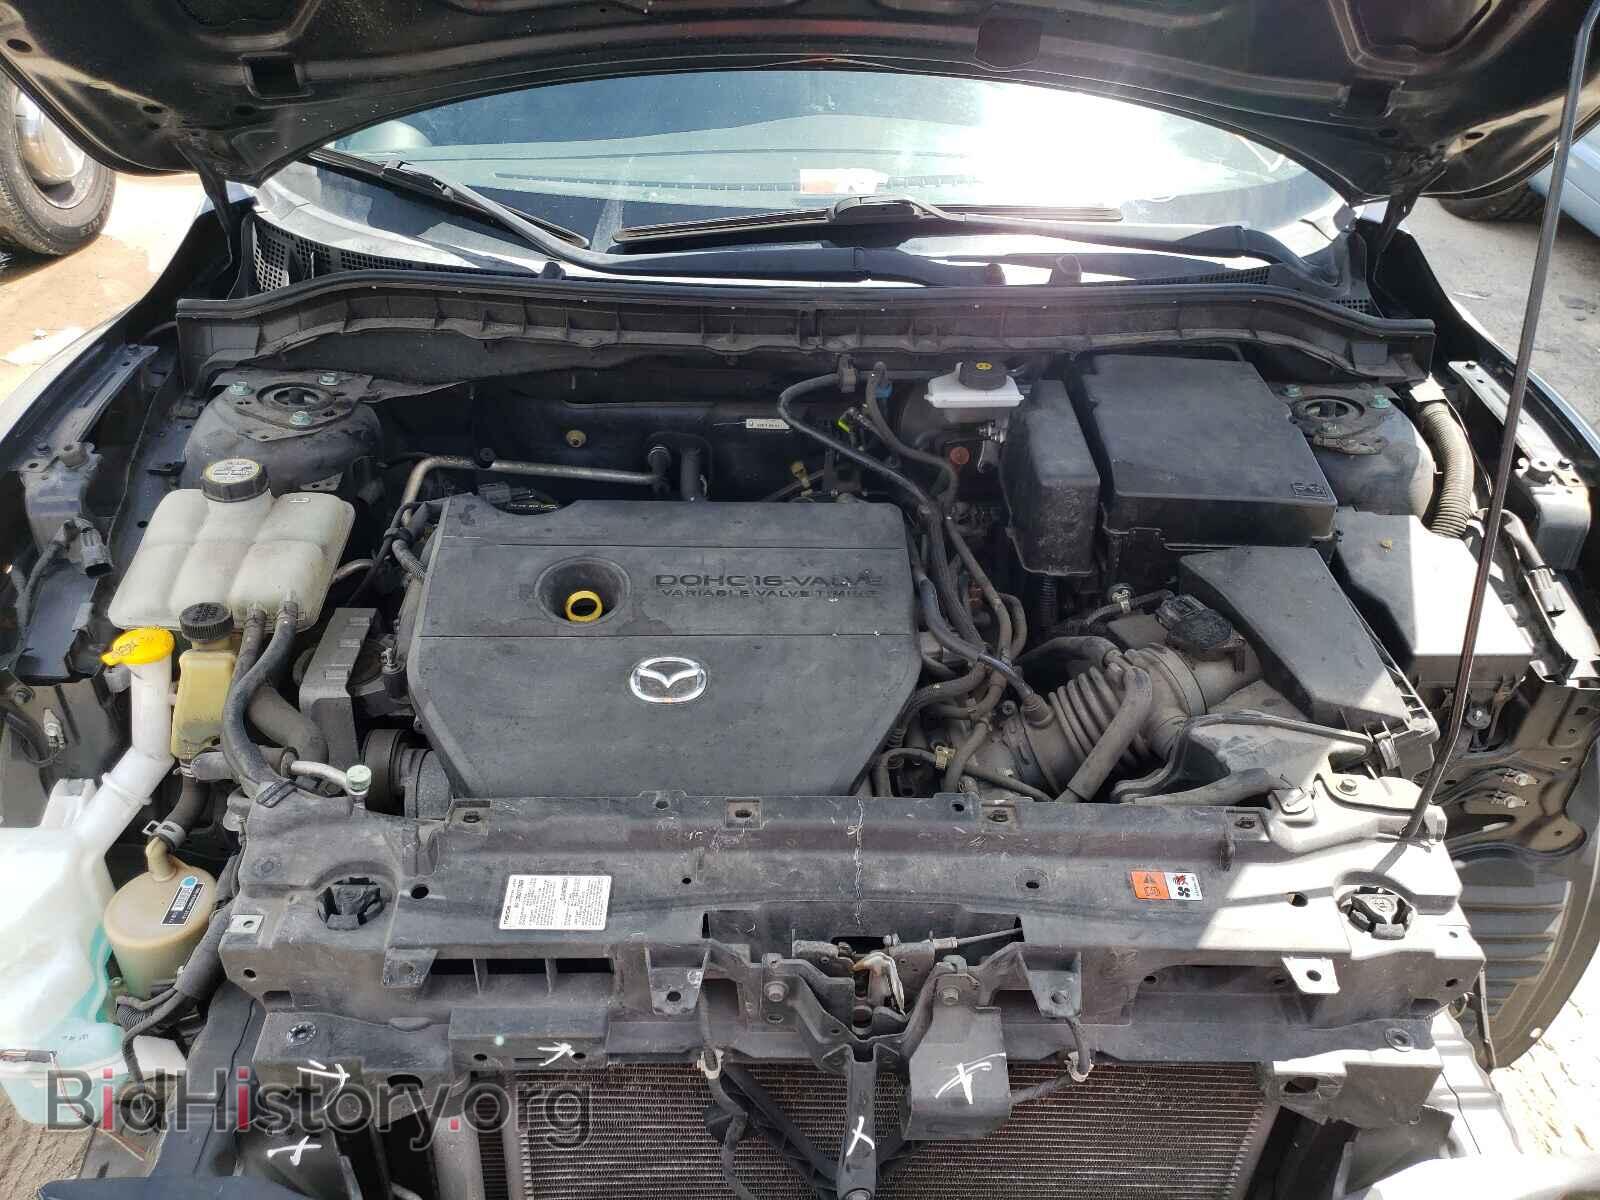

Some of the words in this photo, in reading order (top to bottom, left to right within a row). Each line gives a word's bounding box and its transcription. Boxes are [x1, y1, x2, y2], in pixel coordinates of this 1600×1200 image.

[656, 574, 747, 587] DOHC
[662, 589, 751, 599] VARIABLE
[756, 590, 809, 599] VALVE
